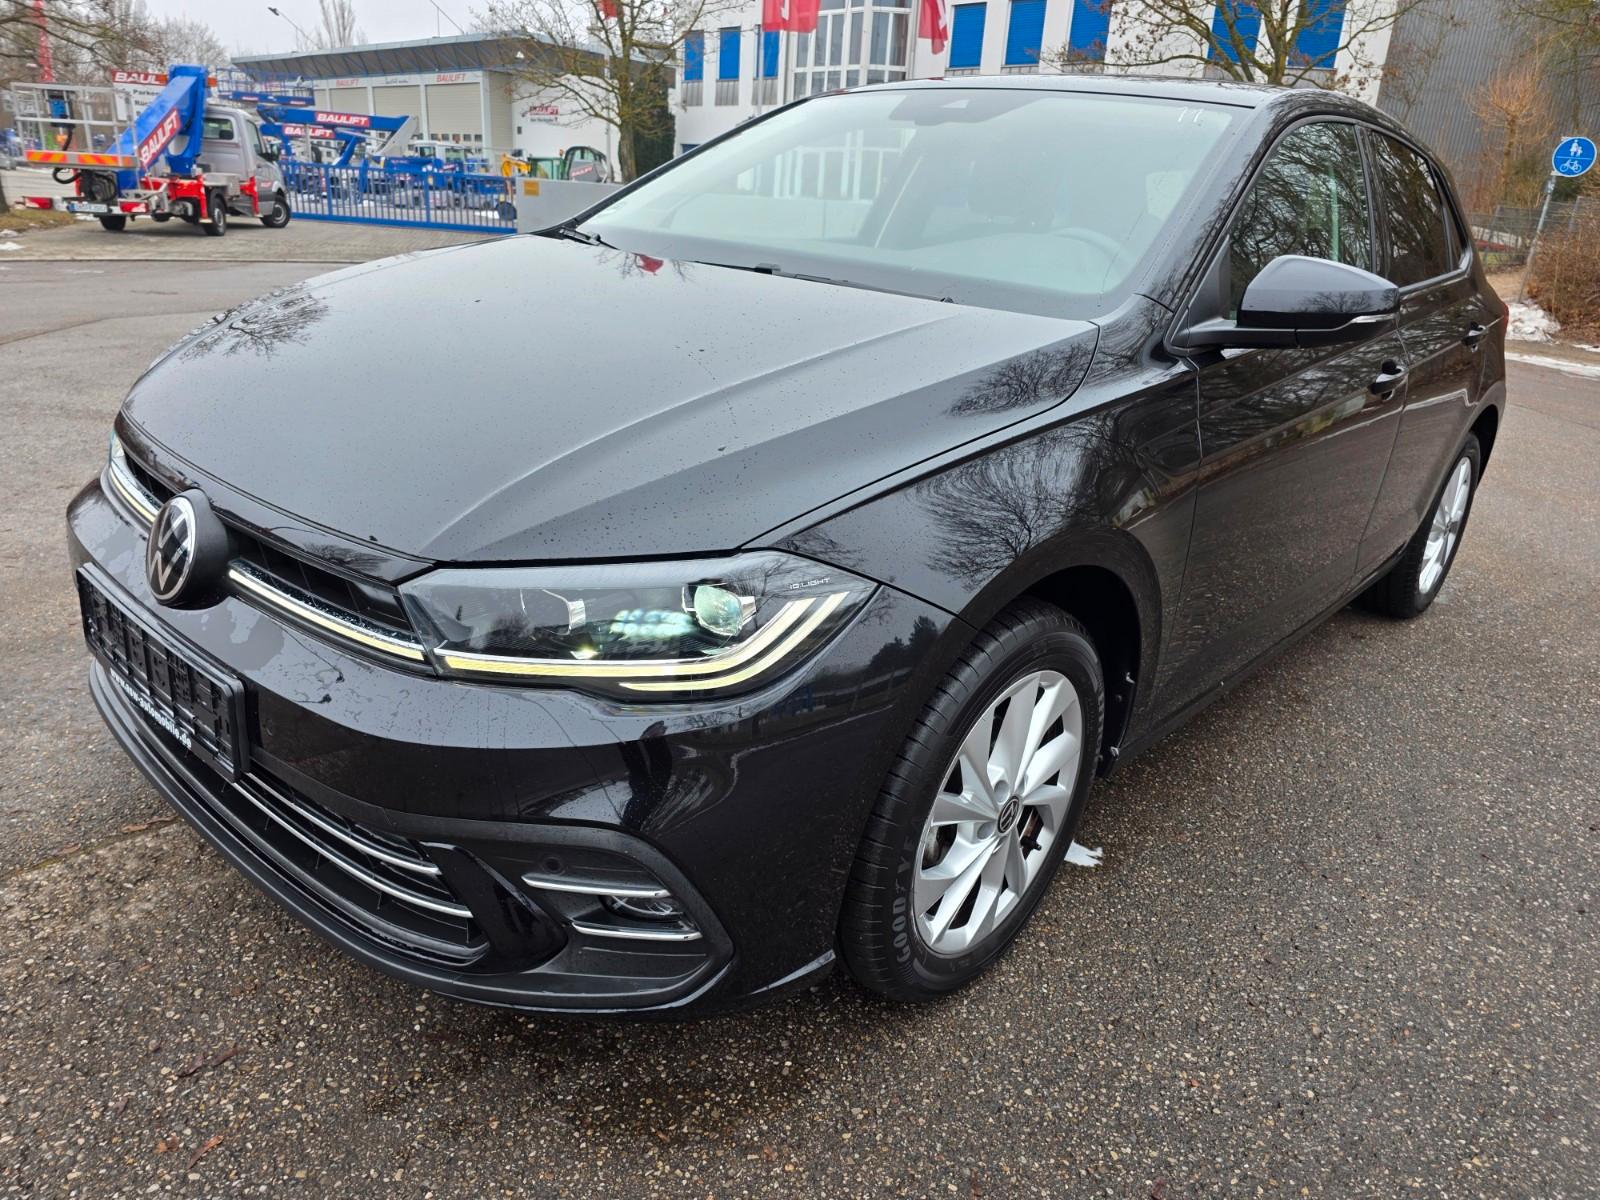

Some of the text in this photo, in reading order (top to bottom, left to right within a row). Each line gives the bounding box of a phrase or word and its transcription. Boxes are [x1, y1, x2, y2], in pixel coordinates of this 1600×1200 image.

[115, 72, 160, 84] BAUL
[316, 113, 369, 126] BAULIFT
[140, 110, 178, 163] BAULIFT
